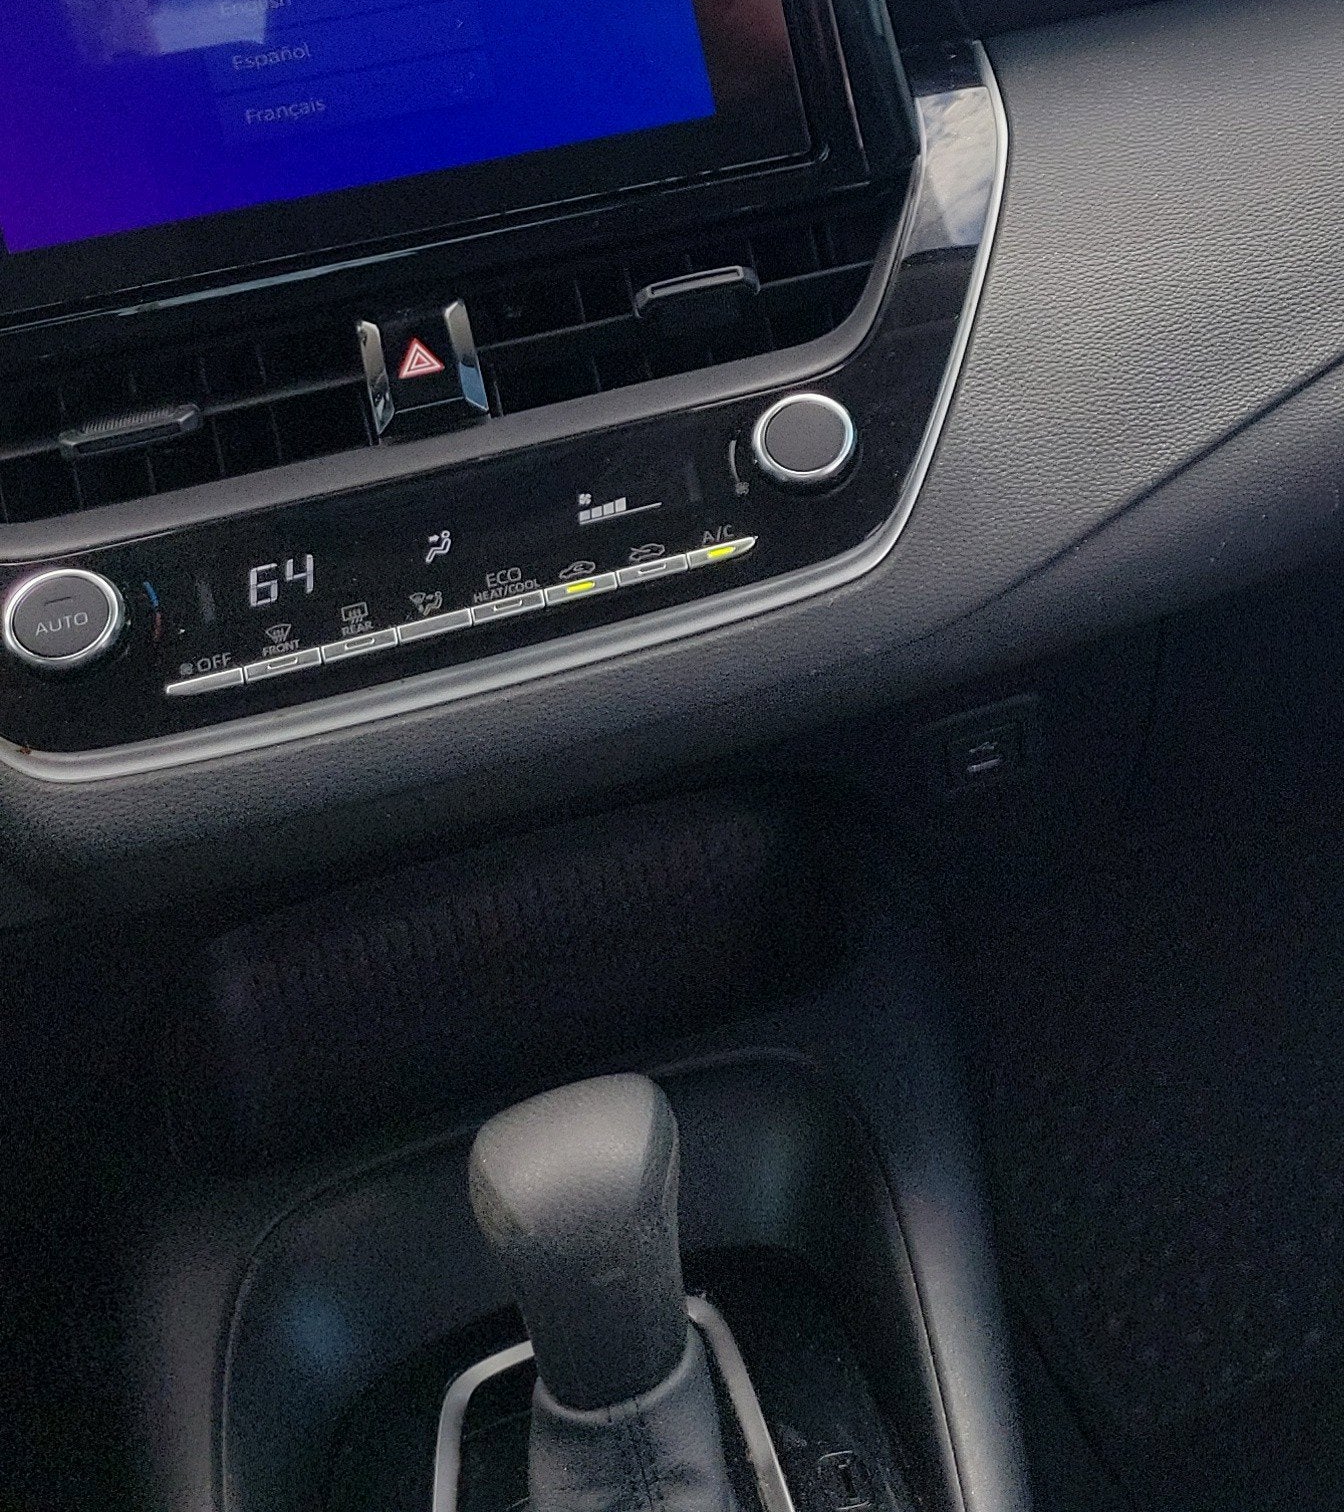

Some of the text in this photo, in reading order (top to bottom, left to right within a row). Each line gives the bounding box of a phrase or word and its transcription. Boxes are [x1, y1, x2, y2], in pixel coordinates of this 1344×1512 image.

[232, 42, 311, 70] Español
[245, 96, 327, 125] Français
[702, 523, 735, 546] A/C
[249, 553, 315, 608] 64
[485, 565, 523, 589] ECO
[473, 578, 542, 604] HEAT/COOL
[35, 611, 89, 637] AUTO
[340, 619, 375, 638] REAR
[262, 638, 301, 658] FRONT
[196, 652, 233, 674] OFF
